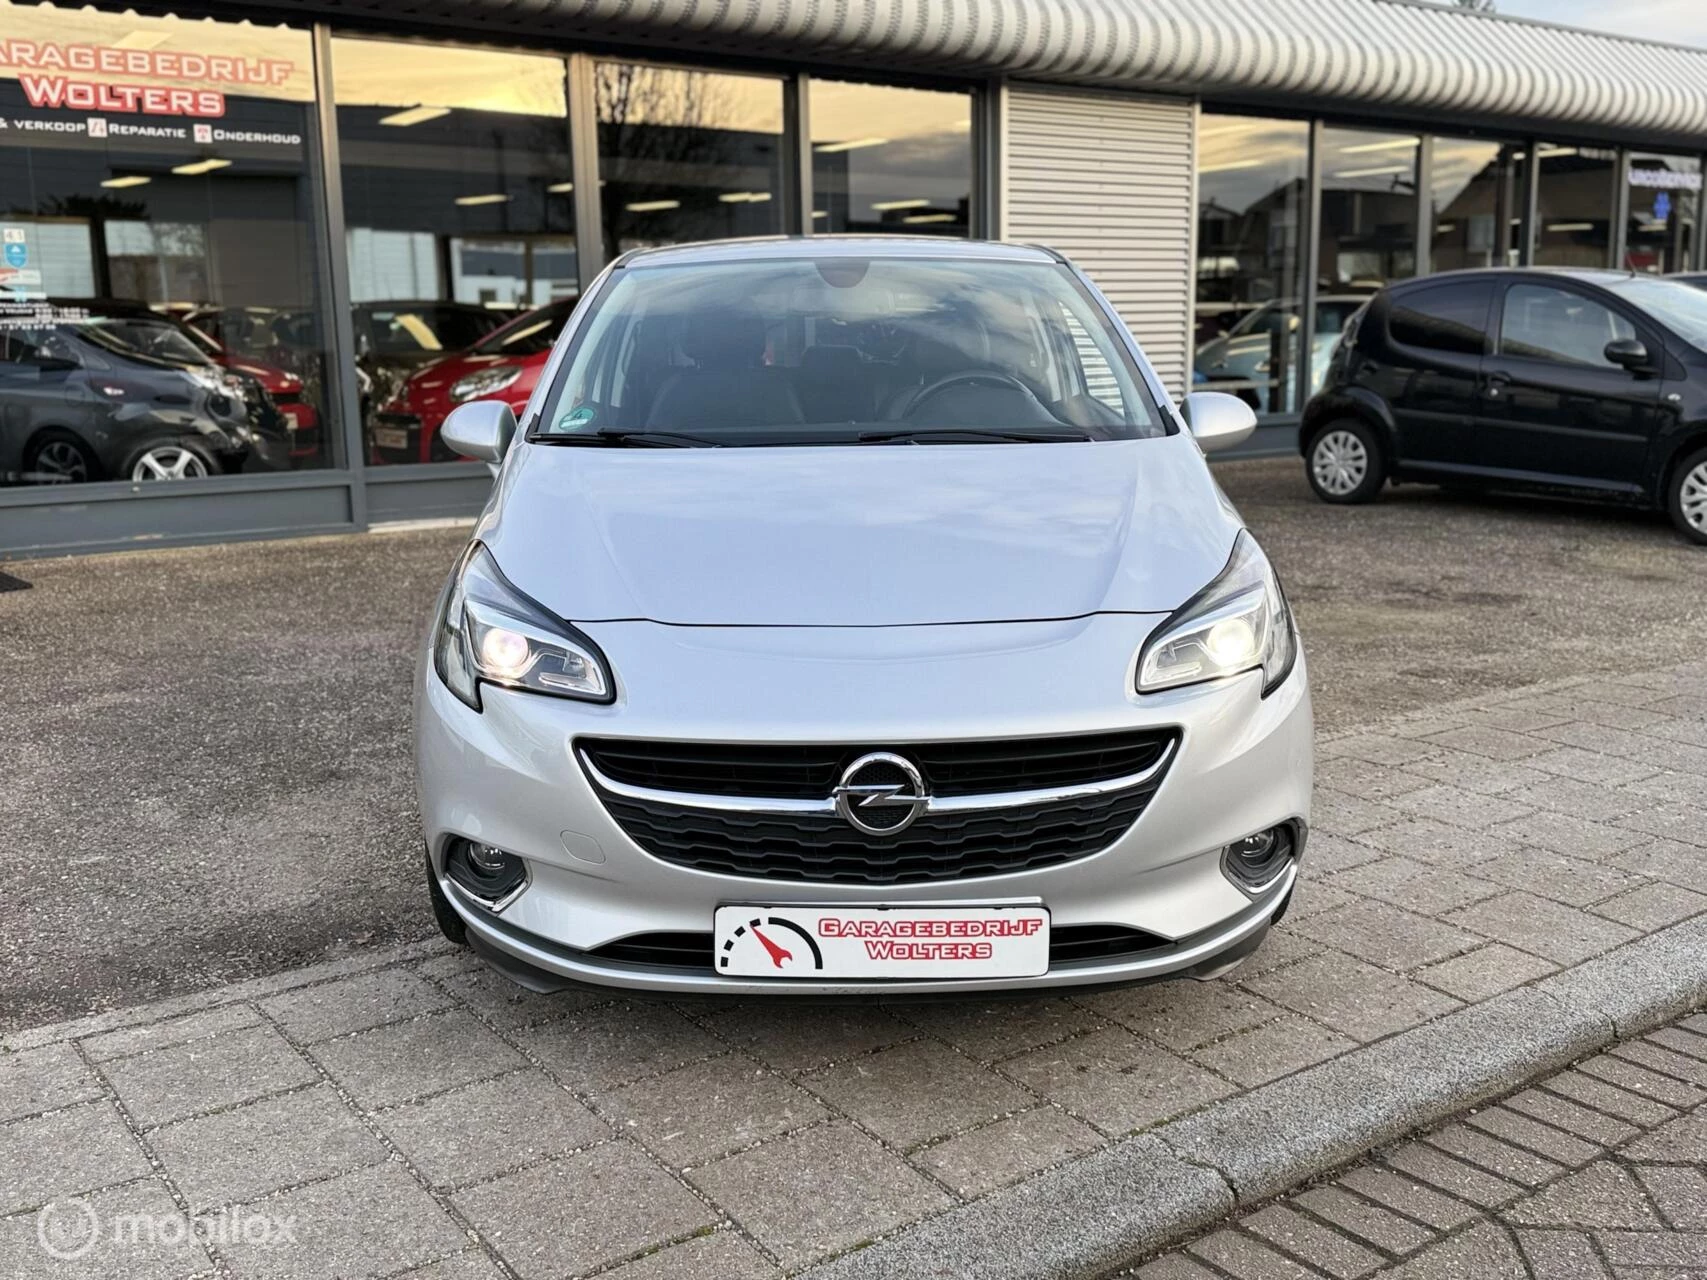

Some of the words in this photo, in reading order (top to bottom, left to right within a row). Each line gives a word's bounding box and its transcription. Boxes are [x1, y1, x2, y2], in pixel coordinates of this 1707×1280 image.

[18, 74, 226, 118] WOLTERS
[14, 120, 86, 132] VERKOOP
[108, 124, 186, 138] REPARATIE
[213, 129, 301, 144] ONDERHOUD
[818, 918, 1043, 937] GARAGEBEDRIJF
[864, 941, 992, 960] WOLTERS
